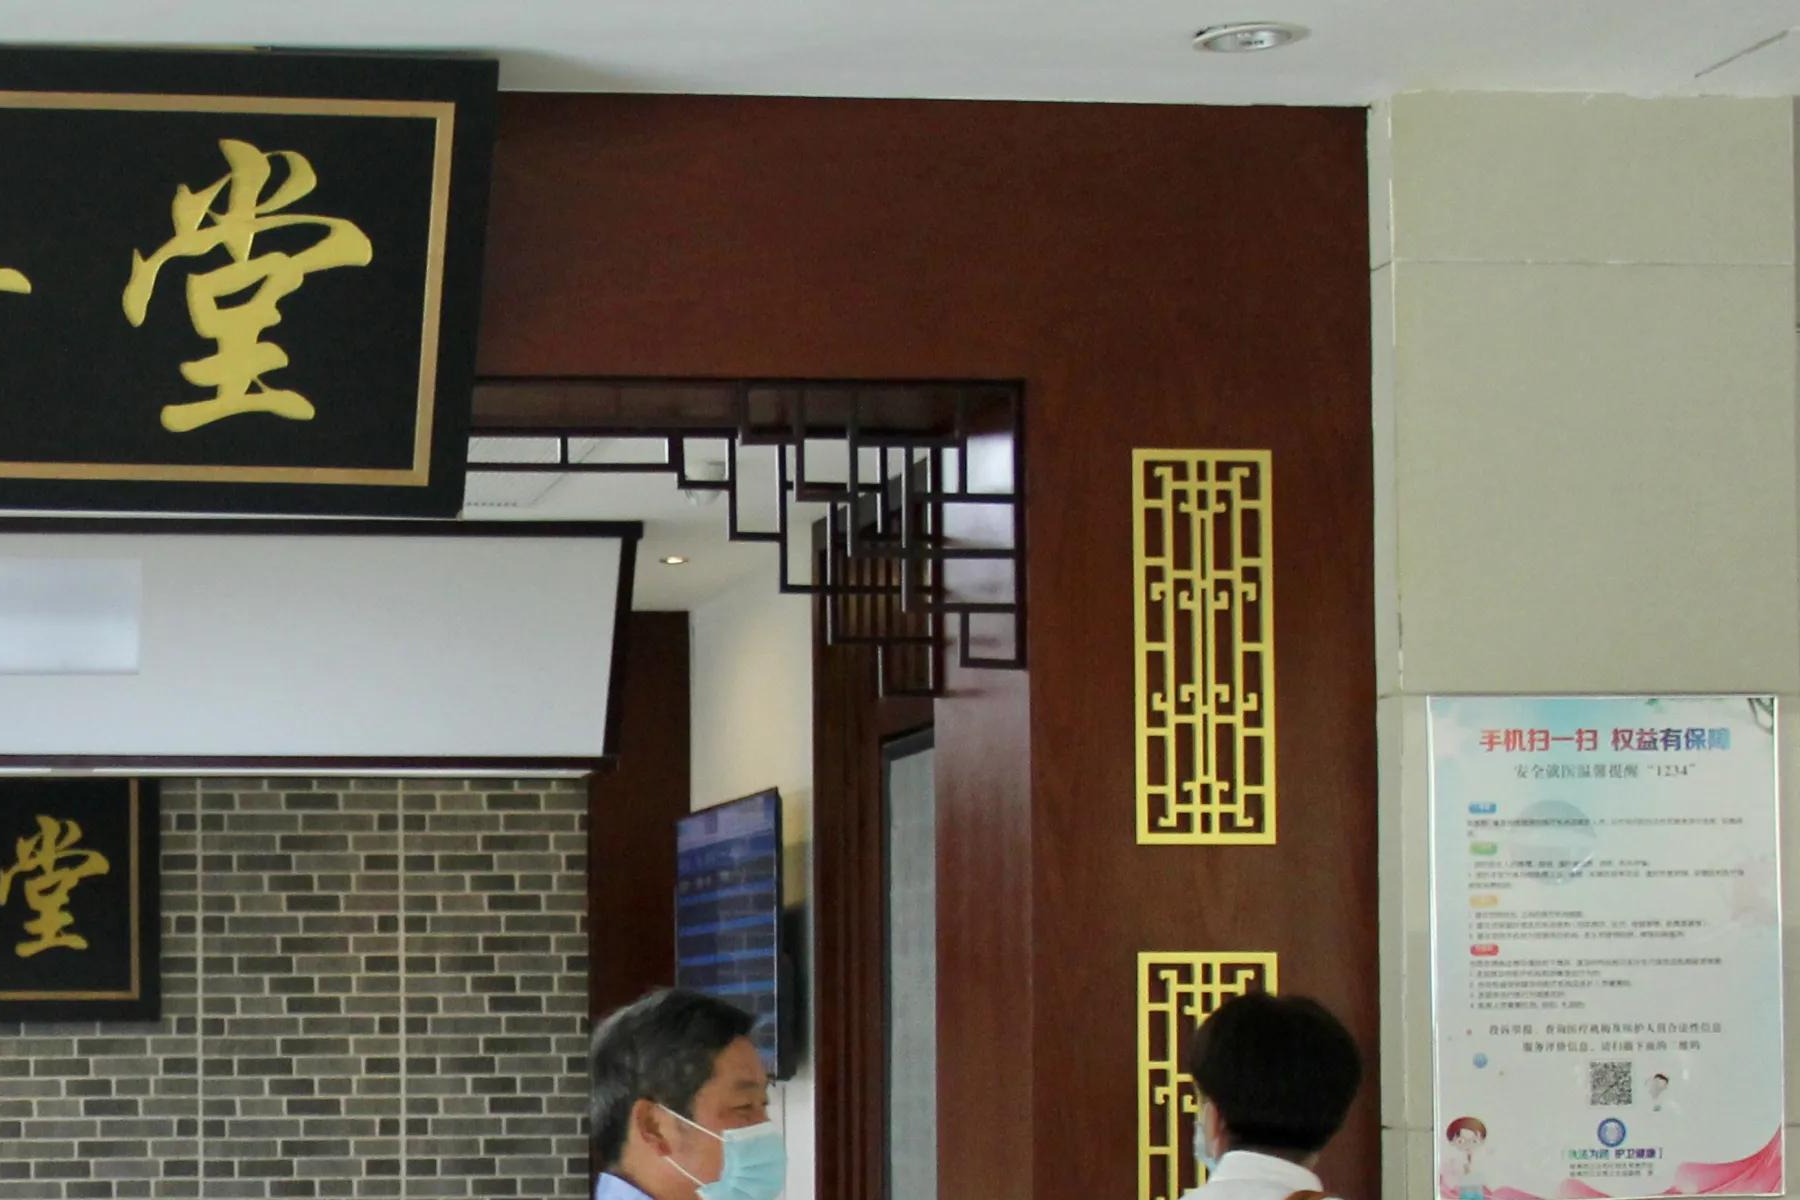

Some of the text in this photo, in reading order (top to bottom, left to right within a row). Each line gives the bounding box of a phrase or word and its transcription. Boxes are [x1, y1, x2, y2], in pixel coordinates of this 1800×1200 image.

[1479, 728, 1598, 752] 手机扫一扫
